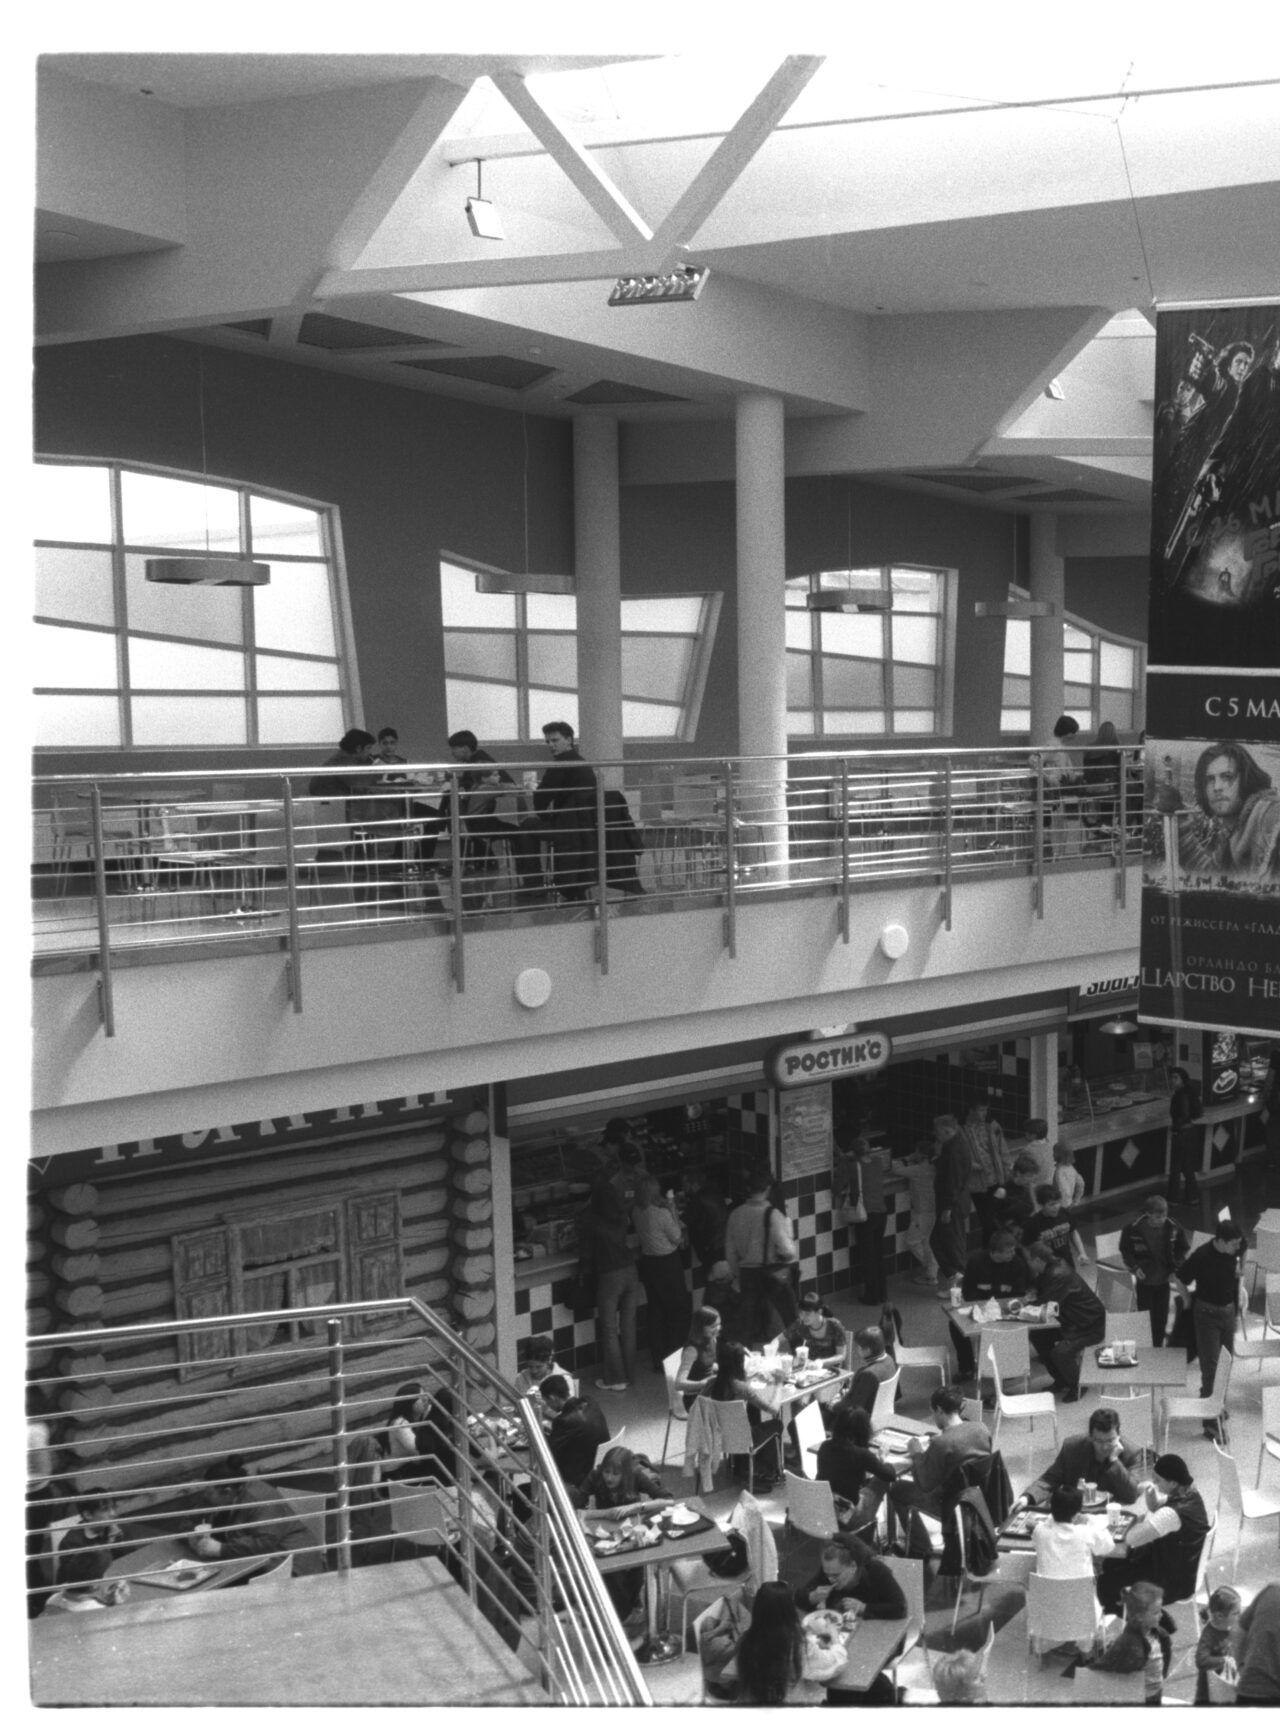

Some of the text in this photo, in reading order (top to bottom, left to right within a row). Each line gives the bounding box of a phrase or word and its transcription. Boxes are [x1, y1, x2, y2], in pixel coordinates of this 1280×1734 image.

[1210, 511, 1241, 541] 26
[1204, 696, 1222, 717] С
[1227, 697, 1239, 717] 5
[1150, 915, 1167, 927] ОТ
[1170, 916, 1240, 932] РЕЖИССЕРА
[1186, 955, 1259, 972] ОРЛАНДО
[1141, 966, 1236, 994] ЦАРСТВО
